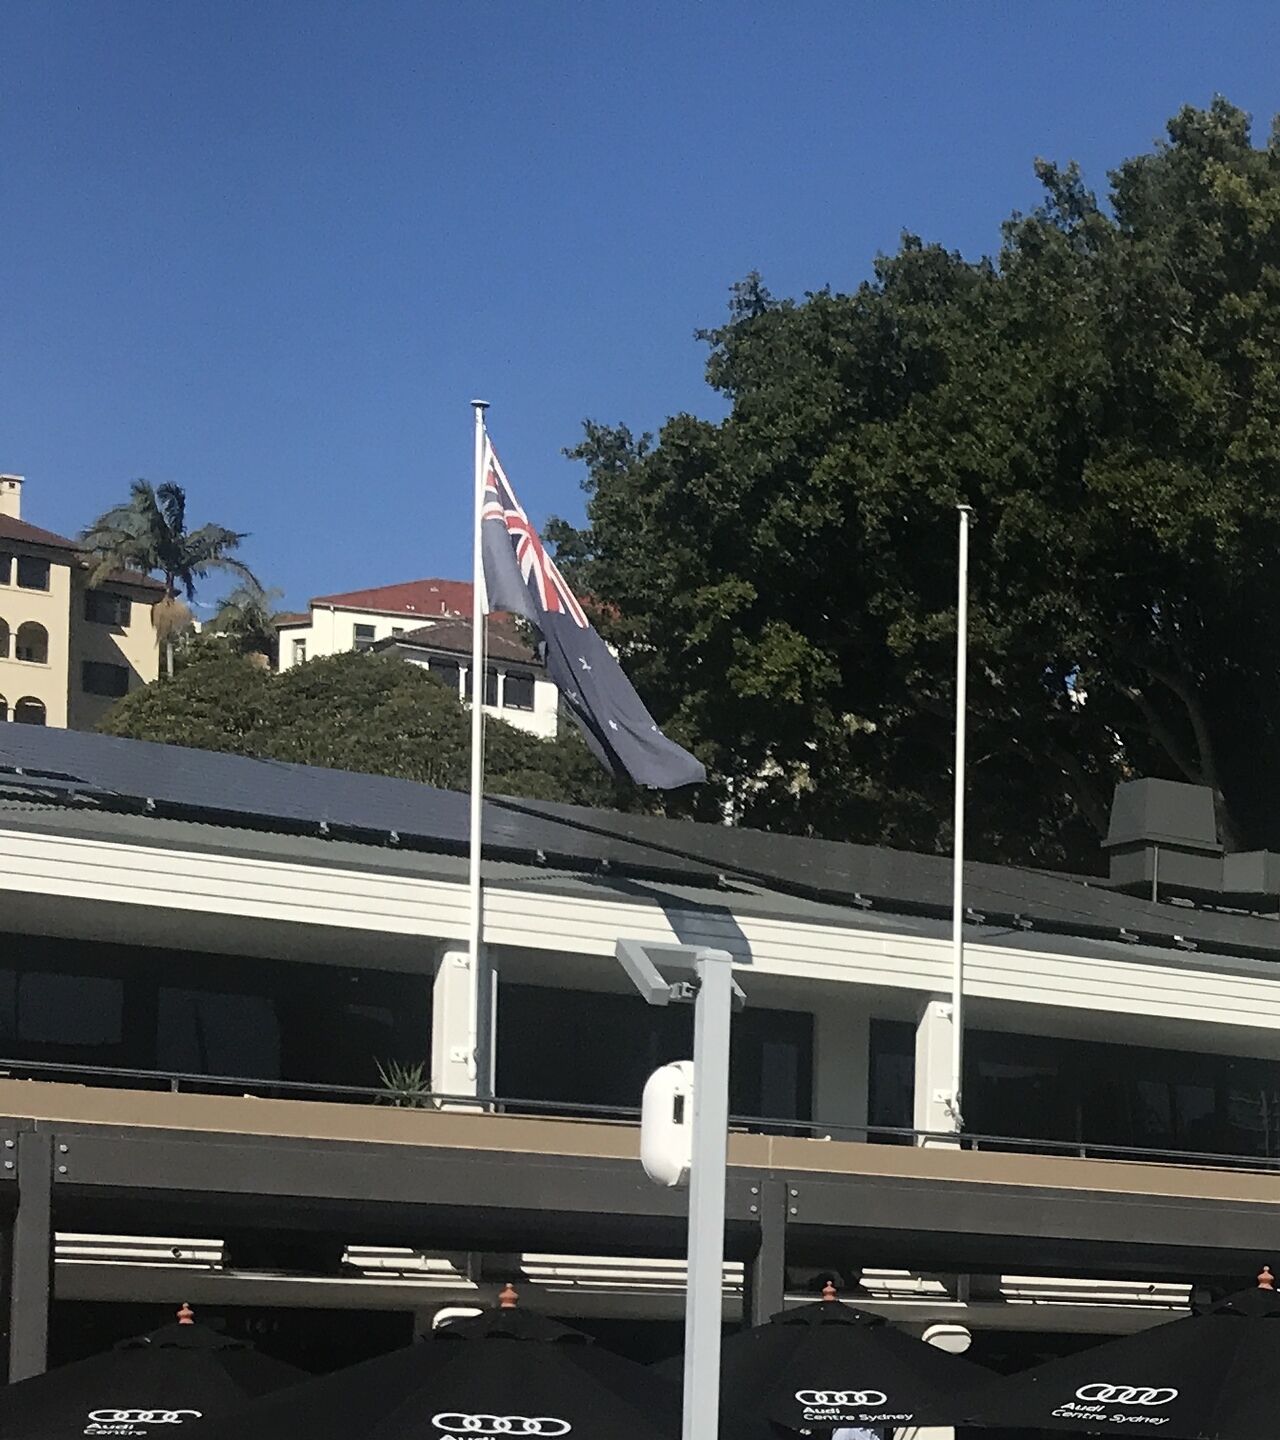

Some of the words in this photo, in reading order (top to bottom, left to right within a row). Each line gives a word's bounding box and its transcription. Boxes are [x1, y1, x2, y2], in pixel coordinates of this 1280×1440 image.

[803, 1406, 840, 1414] Audi
[1060, 1402, 1105, 1412] Audi
[803, 1413, 855, 1421] Centre
[858, 1413, 913, 1422] Sydney
[1051, 1409, 1107, 1421] Centre
[1109, 1413, 1170, 1425] Sydney
[83, 1428, 147, 1436] Centre
